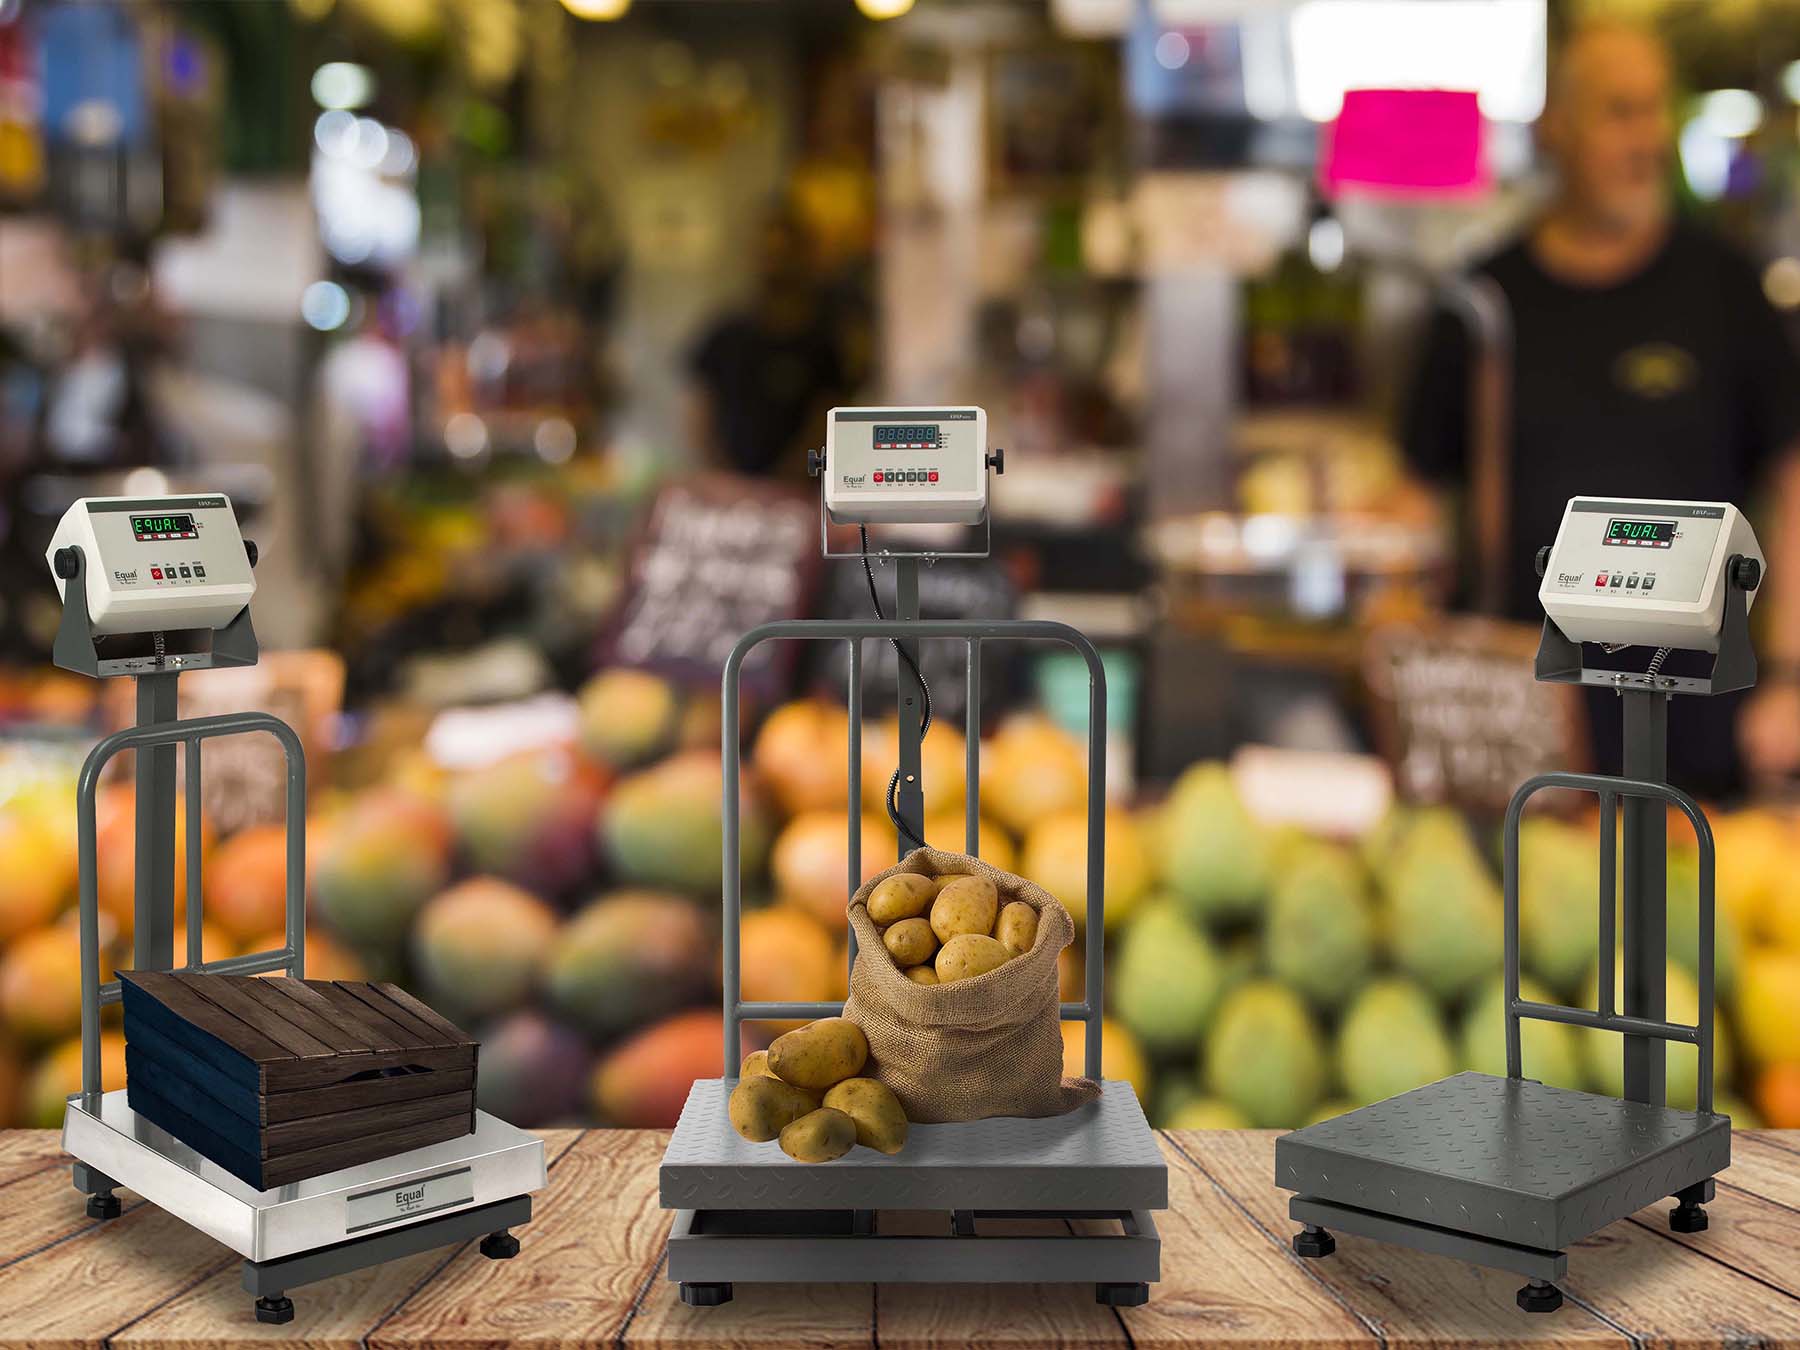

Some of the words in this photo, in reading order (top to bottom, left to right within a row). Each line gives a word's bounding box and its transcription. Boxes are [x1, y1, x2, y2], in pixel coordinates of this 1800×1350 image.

[843, 475, 865, 485] Equal
[114, 570, 138, 582] Equal
[1558, 573, 1582, 585] Equal
[396, 1187, 424, 1207] Equal
